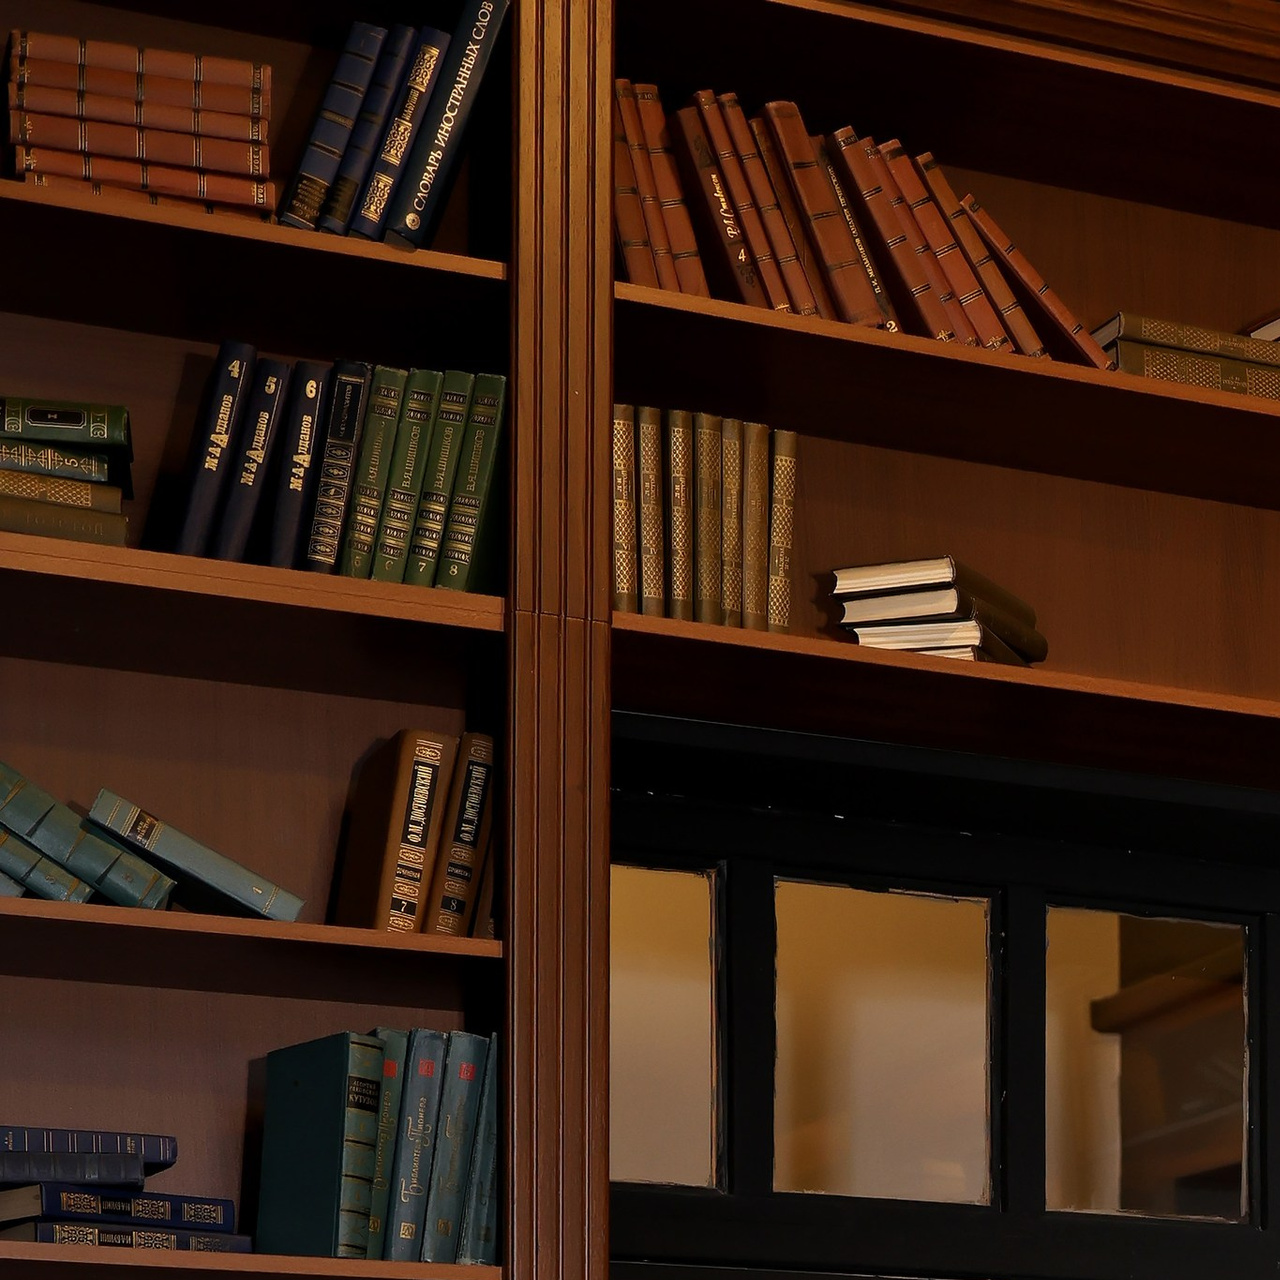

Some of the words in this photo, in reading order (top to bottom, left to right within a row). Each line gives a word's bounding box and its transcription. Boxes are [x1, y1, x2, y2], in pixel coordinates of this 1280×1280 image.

[413, 149, 443, 211] СЛОВАРЬ
[434, 40, 481, 148] ИНОСТРАННЫХ
[471, 0, 494, 40] СЛОВ
[737, 248, 746, 262] 4
[228, 360, 241, 379] 4
[264, 376, 278, 395] 5
[305, 379, 318, 399] 6
[418, 562, 427, 573] 7
[449, 564, 459, 577] 8
[400, 900, 408, 911] 7
[449, 899, 458, 912] 8
